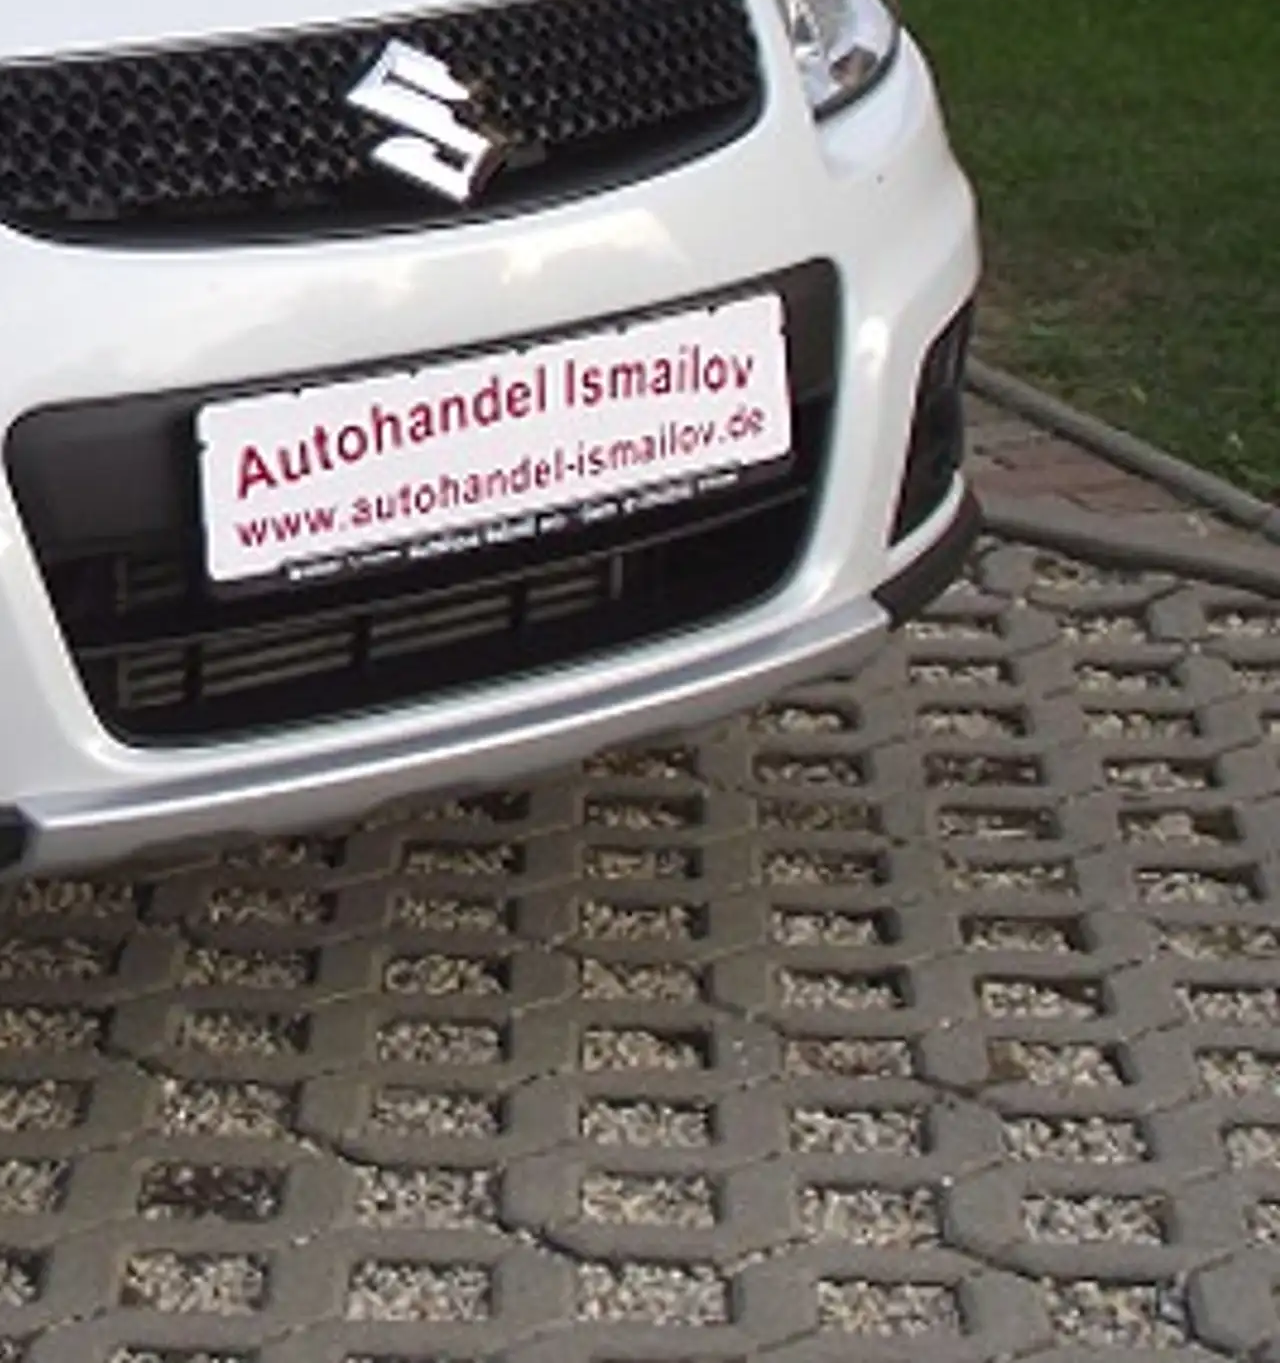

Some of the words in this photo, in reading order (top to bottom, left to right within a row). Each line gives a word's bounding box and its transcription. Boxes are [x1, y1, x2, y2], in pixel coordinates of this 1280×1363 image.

[234, 404, 765, 547] www.autohandel-ismailov.de
[237, 367, 547, 498] Autohandel
[565, 344, 755, 407] Ismailov
